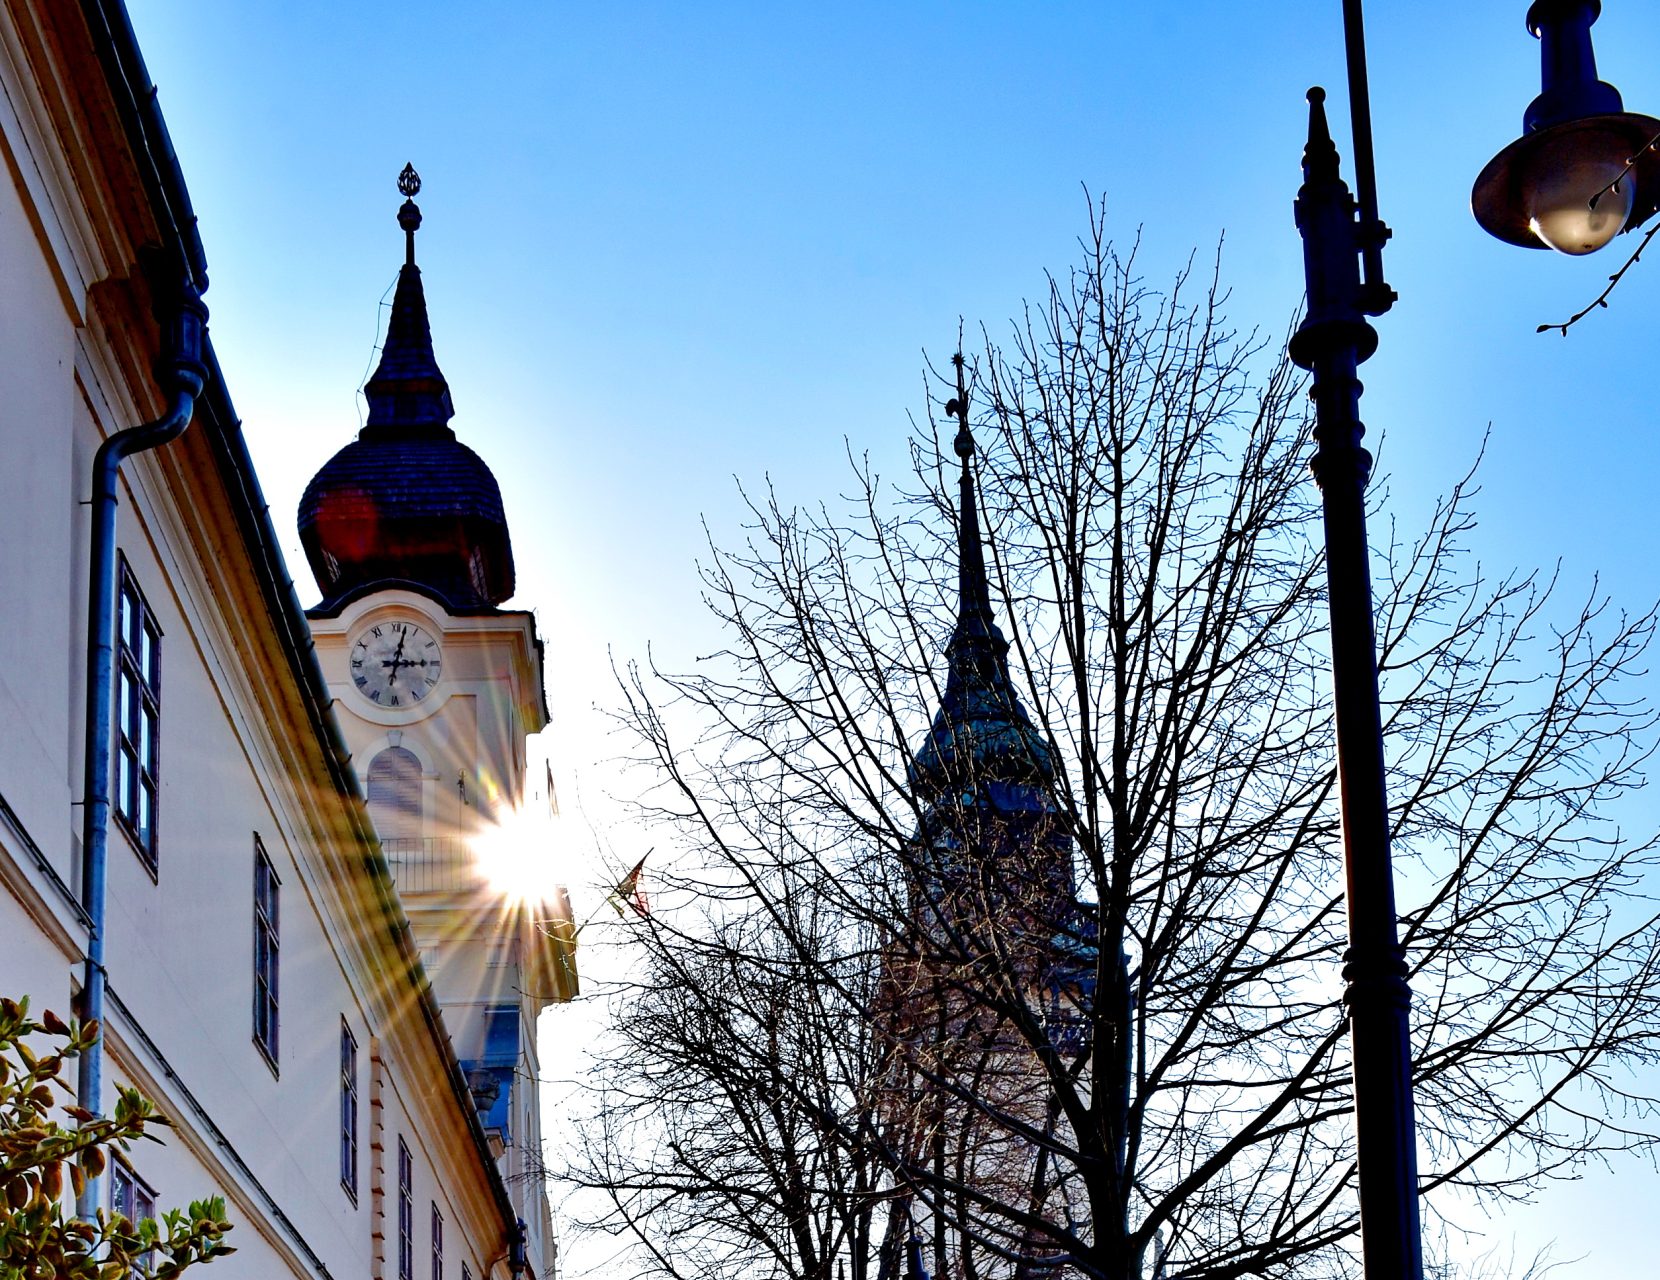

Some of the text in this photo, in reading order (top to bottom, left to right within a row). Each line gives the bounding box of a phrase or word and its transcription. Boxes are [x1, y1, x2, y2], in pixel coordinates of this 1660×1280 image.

[371, 626, 382, 638] XI
[391, 623, 401, 633] XII
[412, 627, 418, 636] I
[357, 640, 368, 650] X
